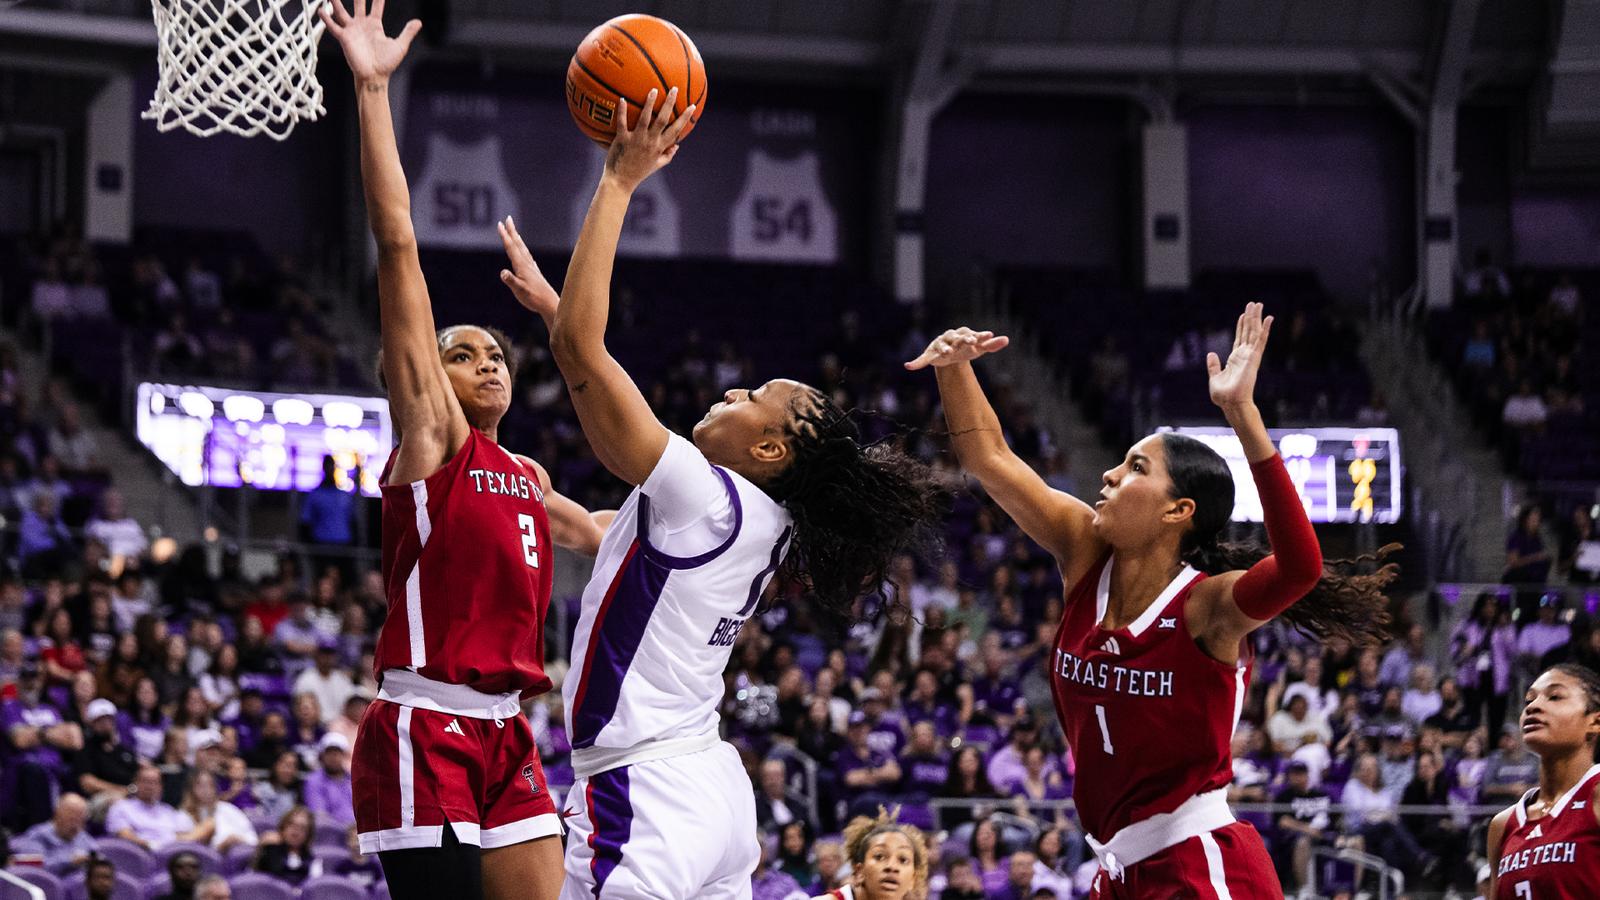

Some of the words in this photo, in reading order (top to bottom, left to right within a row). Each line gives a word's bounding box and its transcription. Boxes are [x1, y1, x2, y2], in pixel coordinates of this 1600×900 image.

[433, 182, 495, 227] 50
[752, 196, 812, 243] 54
[469, 468, 529, 500] TEXAS
[518, 513, 539, 569] 2
[1055, 647, 1109, 689] TEXAS
[1113, 666, 1174, 696] TECH
[1095, 704, 1114, 756] 1
[1497, 848, 1531, 878] EXAS
[1533, 842, 1577, 865] TECH
